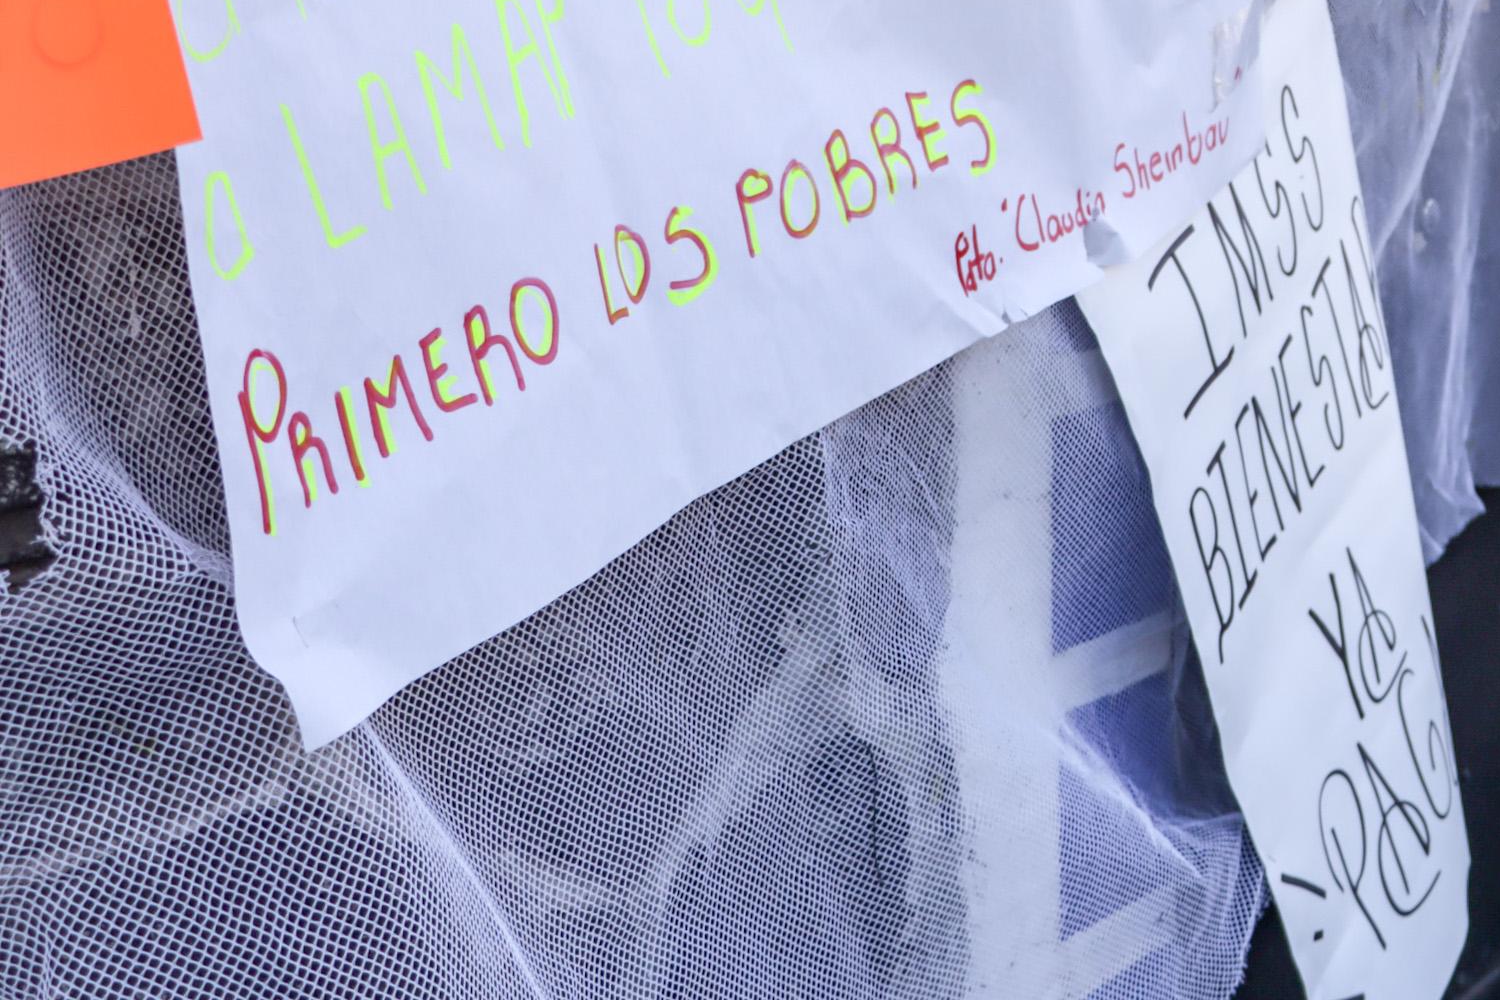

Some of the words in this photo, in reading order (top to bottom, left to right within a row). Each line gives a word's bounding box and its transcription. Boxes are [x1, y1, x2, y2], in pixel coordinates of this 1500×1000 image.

[237, 277, 561, 536] PRIMERO
[593, 206, 720, 326] LOS
[735, 78, 999, 260] POBRES
[1149, 83, 1324, 420] IMSS
[1308, 547, 1408, 720] YA
